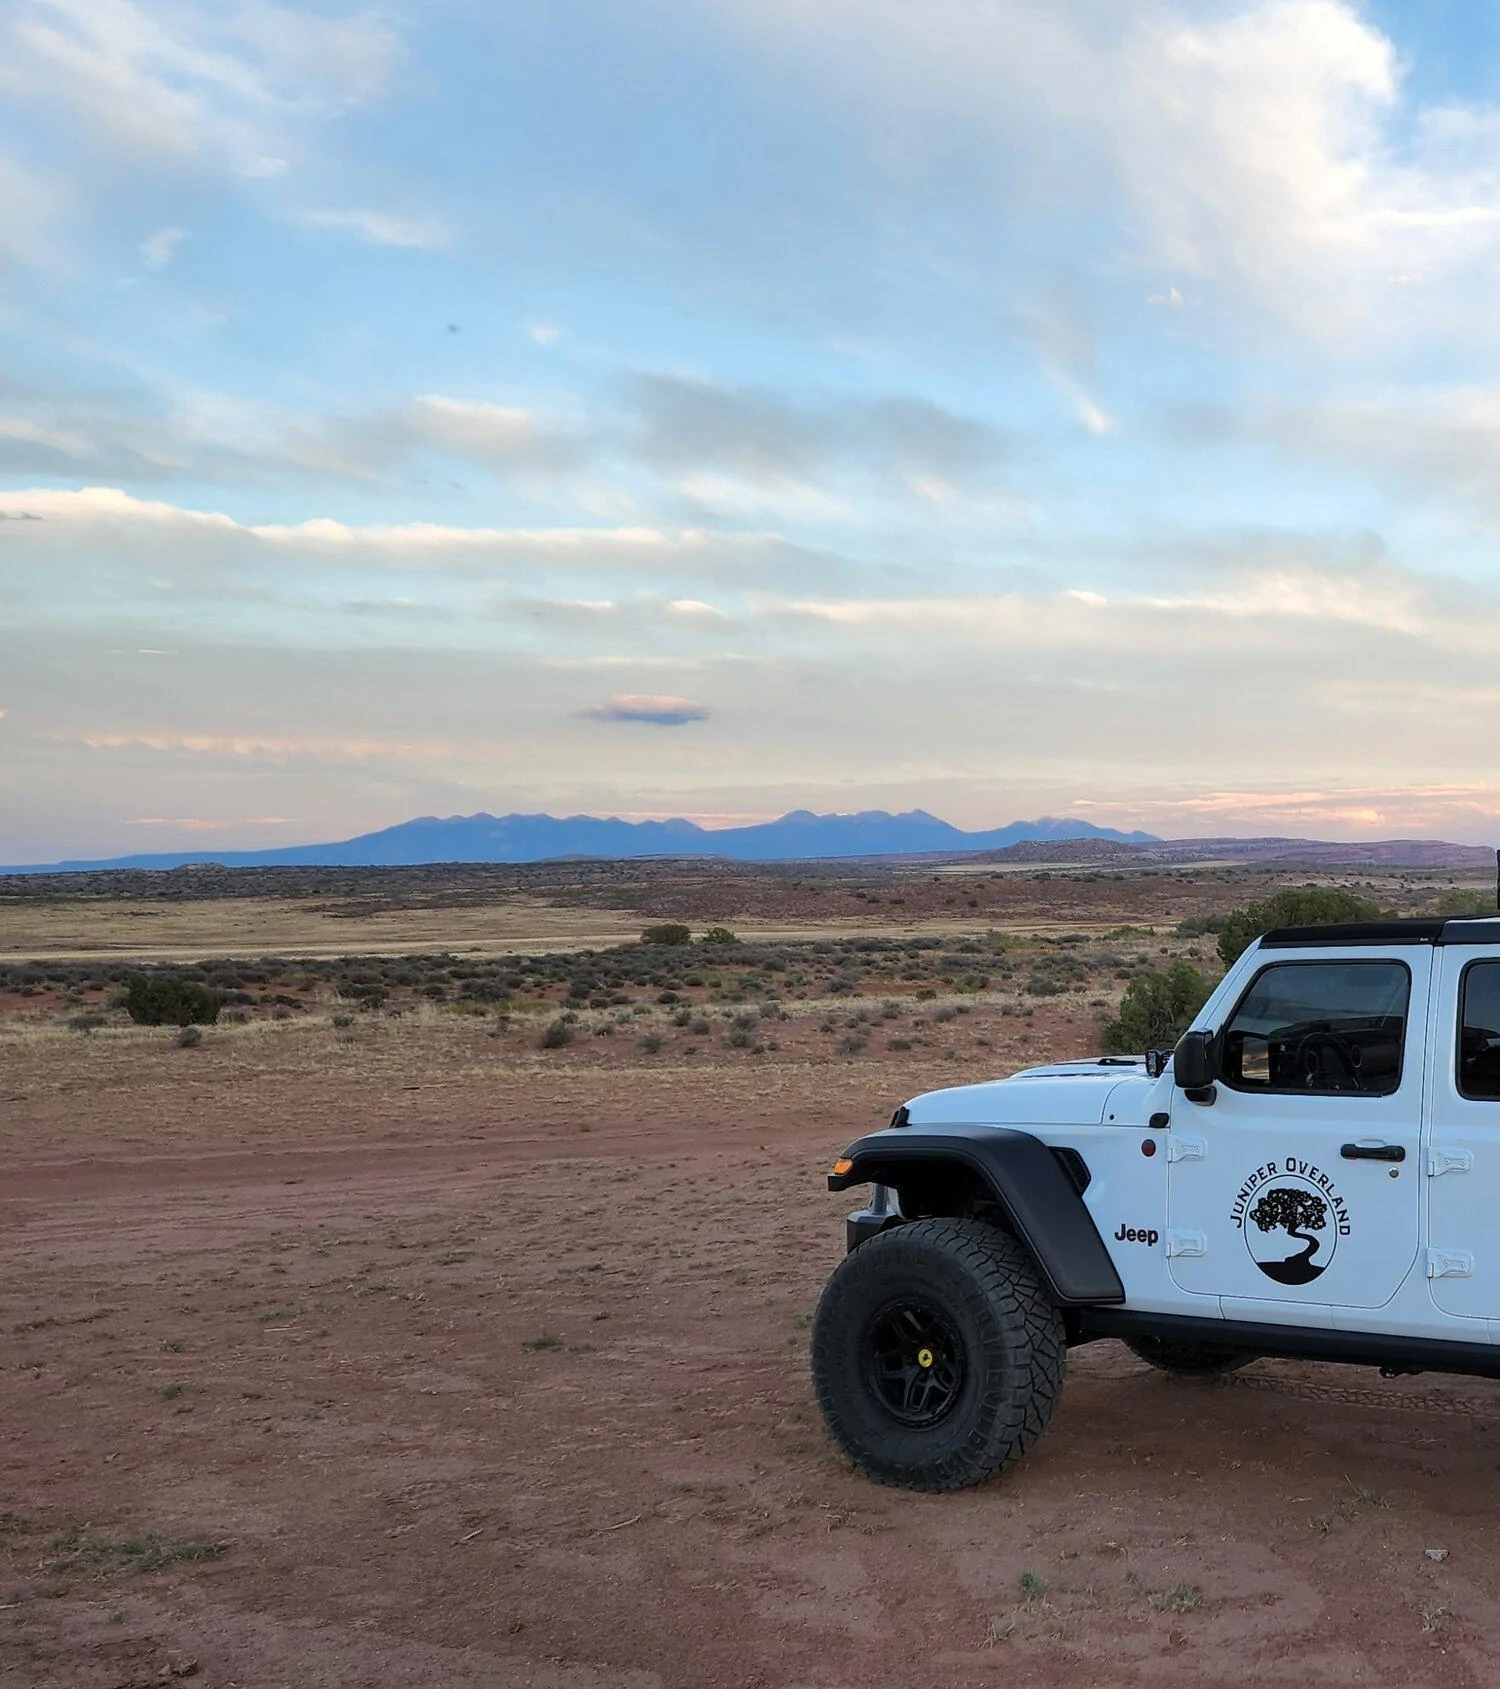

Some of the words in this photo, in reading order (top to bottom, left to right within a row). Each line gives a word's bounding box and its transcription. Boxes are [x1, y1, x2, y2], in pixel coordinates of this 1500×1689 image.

[1230, 1161, 1278, 1229] JUNIPER
[1285, 1157, 1350, 1236] OVERLAND
[1114, 1224, 1159, 1246] Jeep
